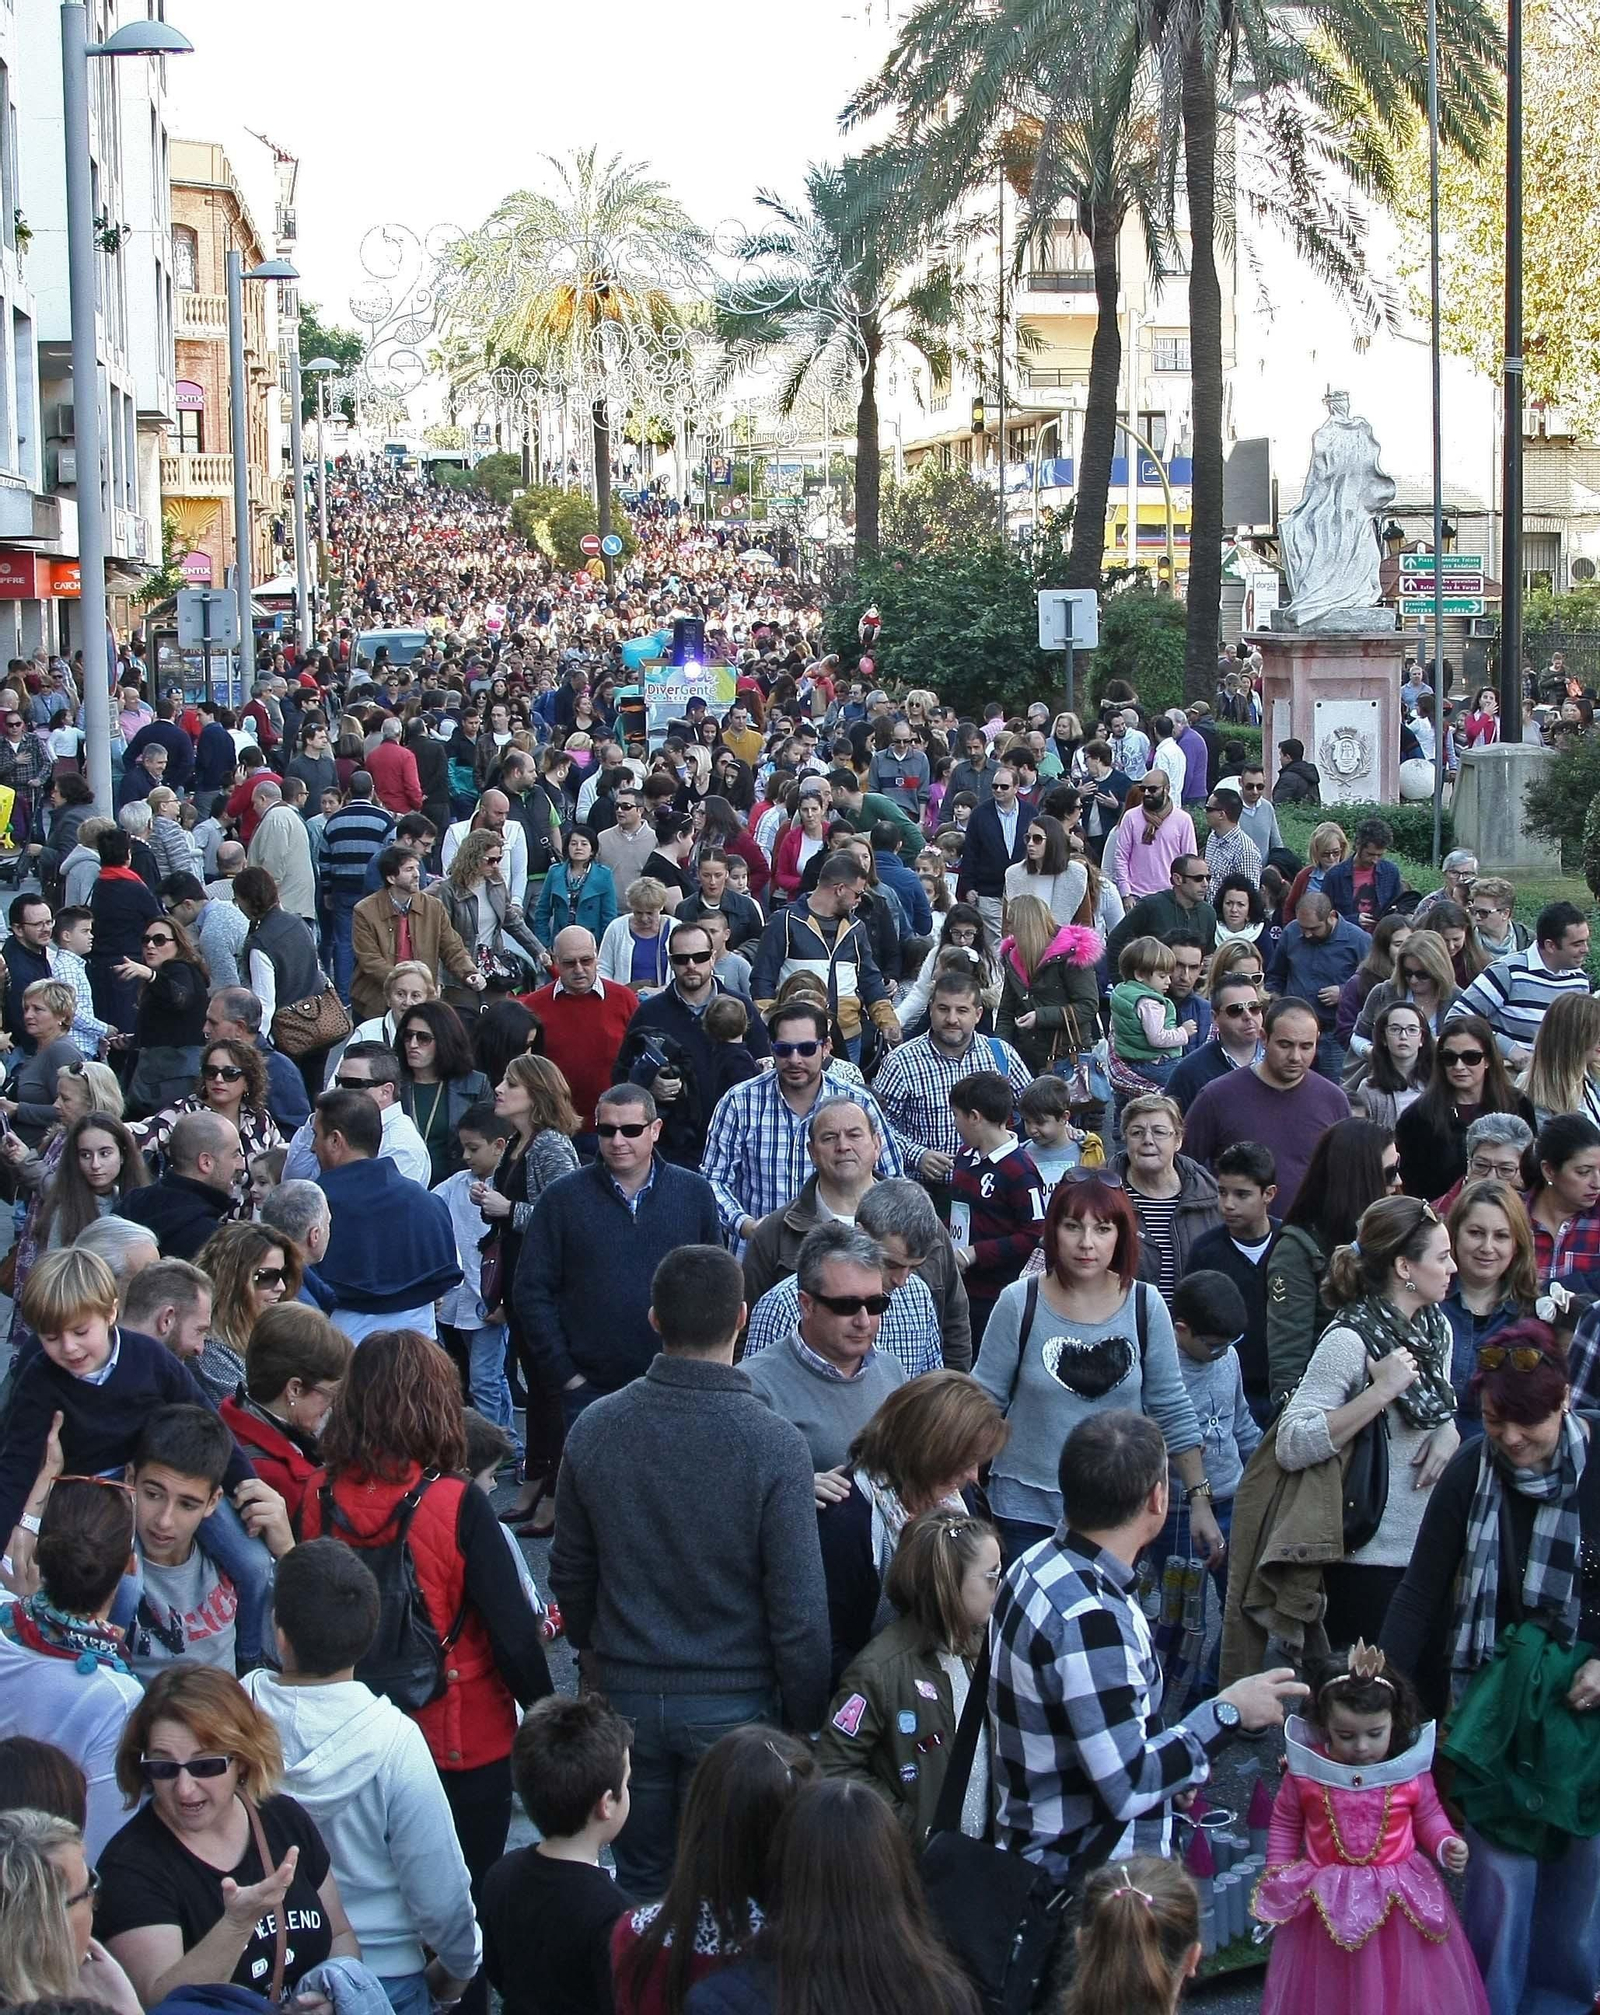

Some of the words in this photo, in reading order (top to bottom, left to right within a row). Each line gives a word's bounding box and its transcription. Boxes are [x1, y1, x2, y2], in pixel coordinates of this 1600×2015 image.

[647, 684, 717, 696] DiverGente
[832, 1693, 867, 1737] A
[254, 1909, 321, 1940] WEEEND
